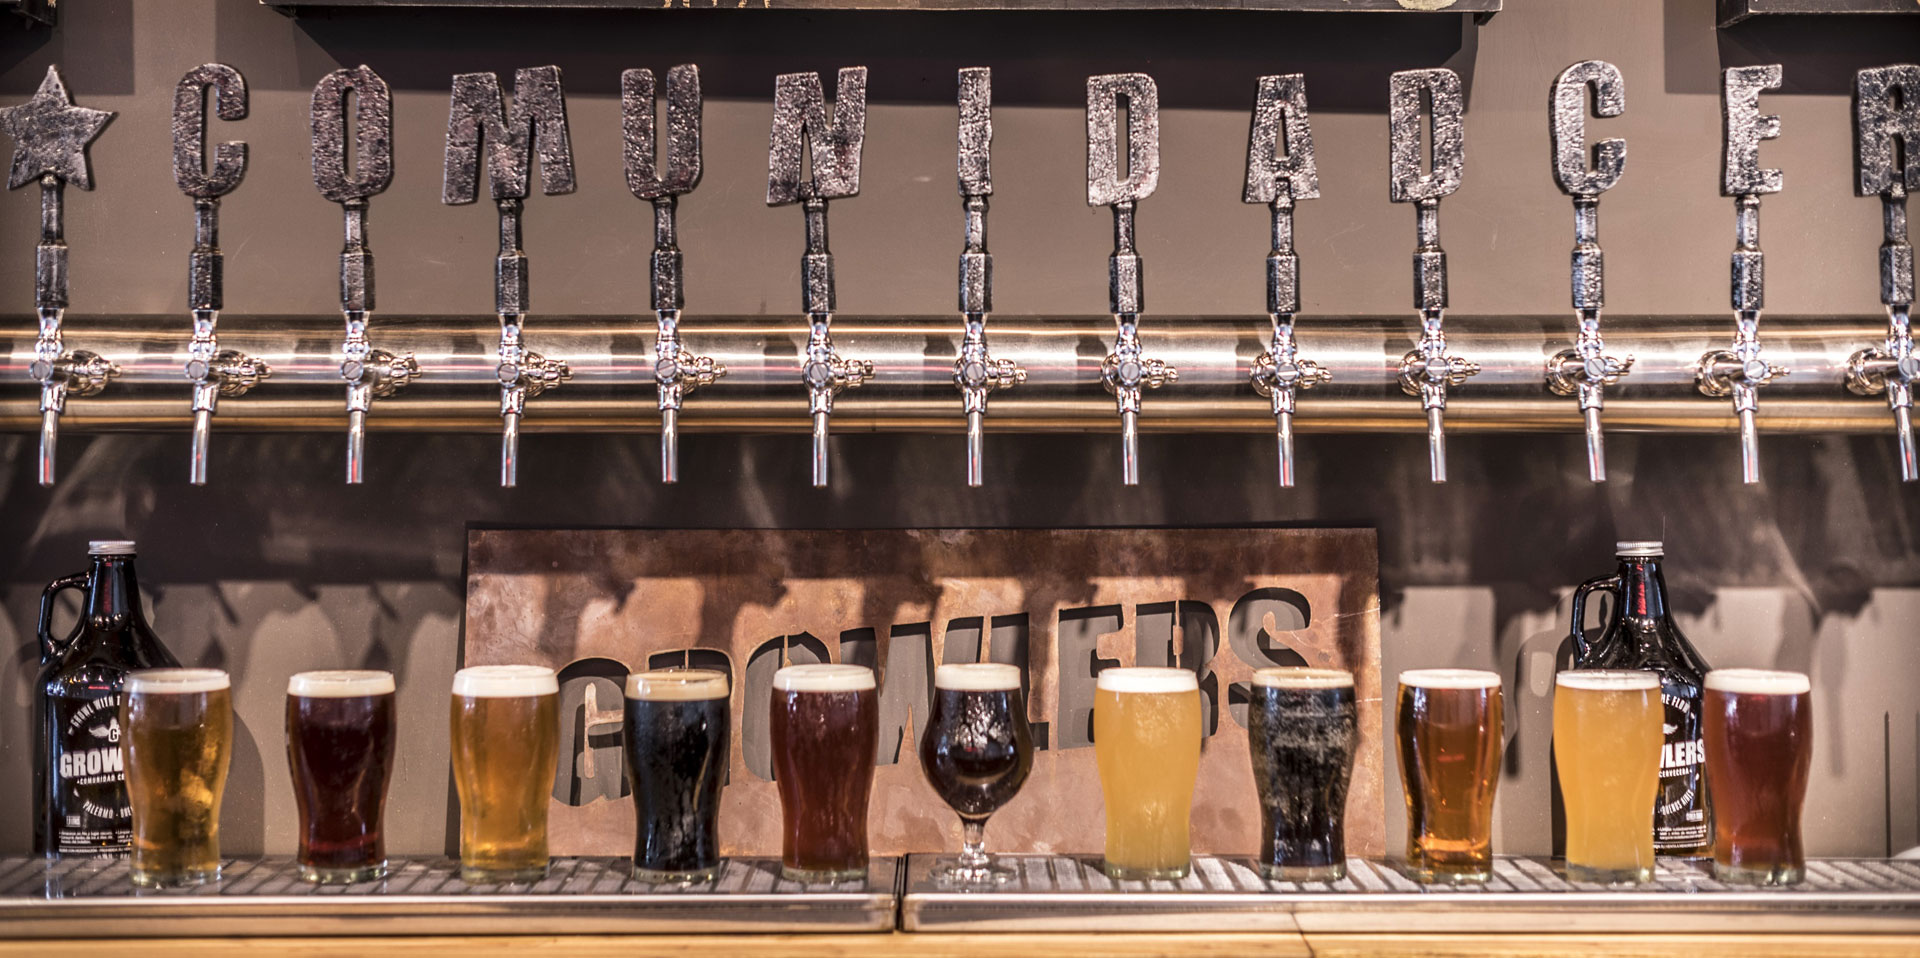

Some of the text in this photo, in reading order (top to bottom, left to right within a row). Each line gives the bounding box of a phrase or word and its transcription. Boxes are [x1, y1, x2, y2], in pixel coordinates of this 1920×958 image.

[70, 702, 94, 728] GROWL
[93, 695, 114, 710] WITH
[552, 586, 1312, 807] GOWERS
[60, 747, 124, 778] GROW
[1660, 738, 1705, 768] LERS
[80, 774, 116, 785] COMUNIDAD
[82, 800, 114, 819] PALERMO
